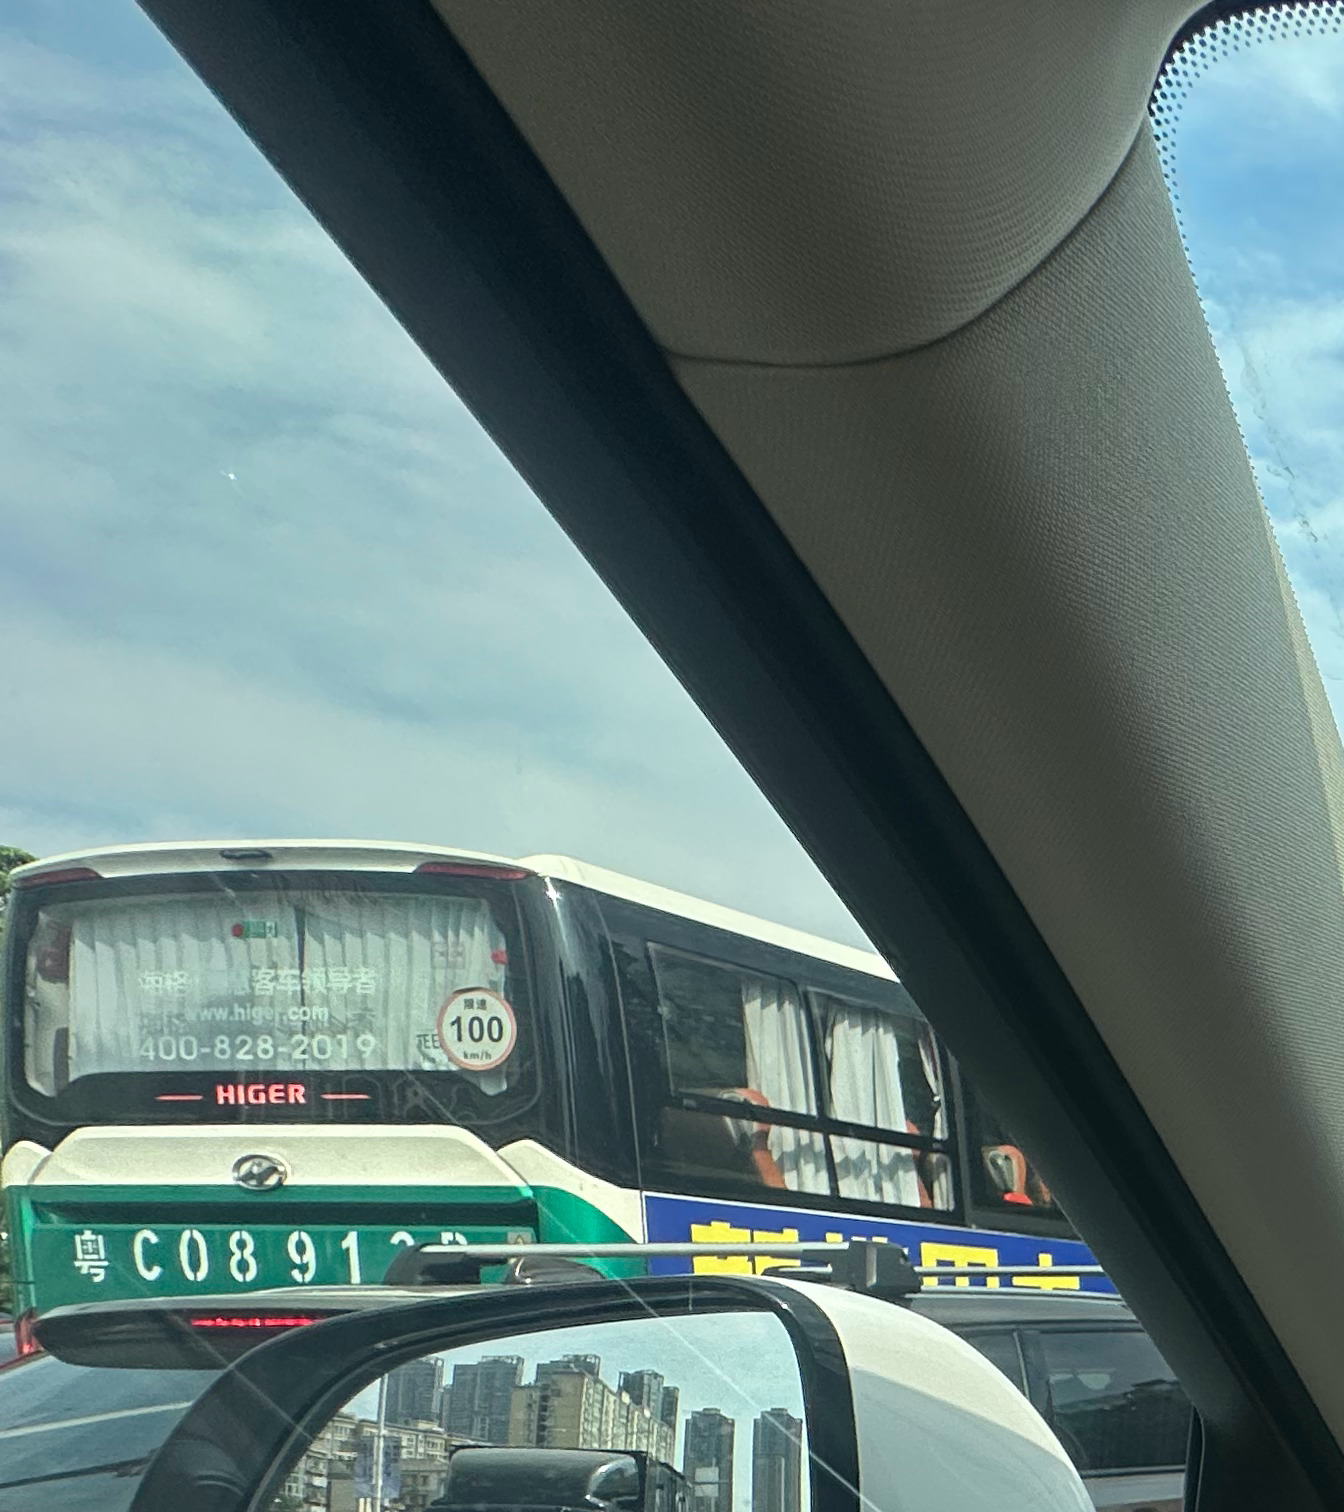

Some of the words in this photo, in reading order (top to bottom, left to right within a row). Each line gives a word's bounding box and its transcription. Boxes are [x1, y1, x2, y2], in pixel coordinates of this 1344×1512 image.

[450, 1016, 504, 1043] 100
[140, 1034, 377, 1061] 400-828-2019
[216, 1083, 306, 1106] HIGER
